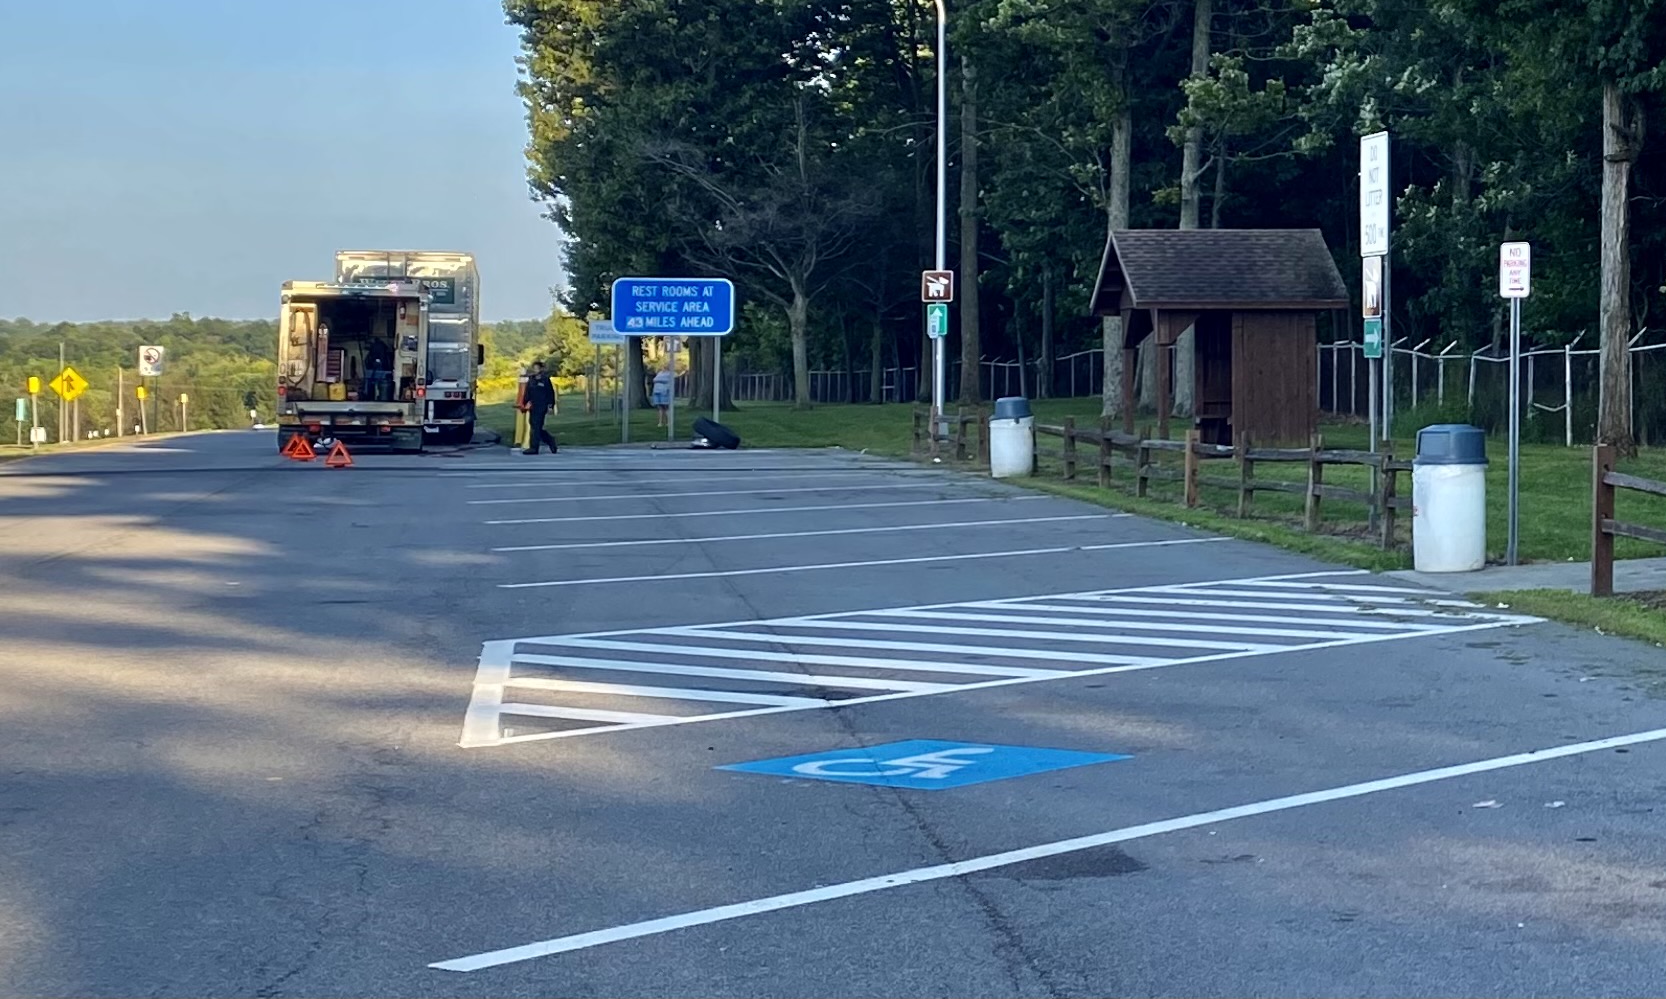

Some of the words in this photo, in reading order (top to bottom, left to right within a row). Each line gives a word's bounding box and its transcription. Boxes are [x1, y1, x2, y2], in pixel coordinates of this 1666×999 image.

[1365, 188, 1383, 207] LITTER
[1509, 247, 1522, 258] NO
[631, 285, 657, 297] REST
[661, 285, 699, 297] ROOMS
[702, 285, 714, 297] AT
[635, 301, 678, 313] SERVICE
[682, 301, 711, 313] AREA
[645, 316, 676, 328] MILES
[680, 316, 714, 328] AHEAD
